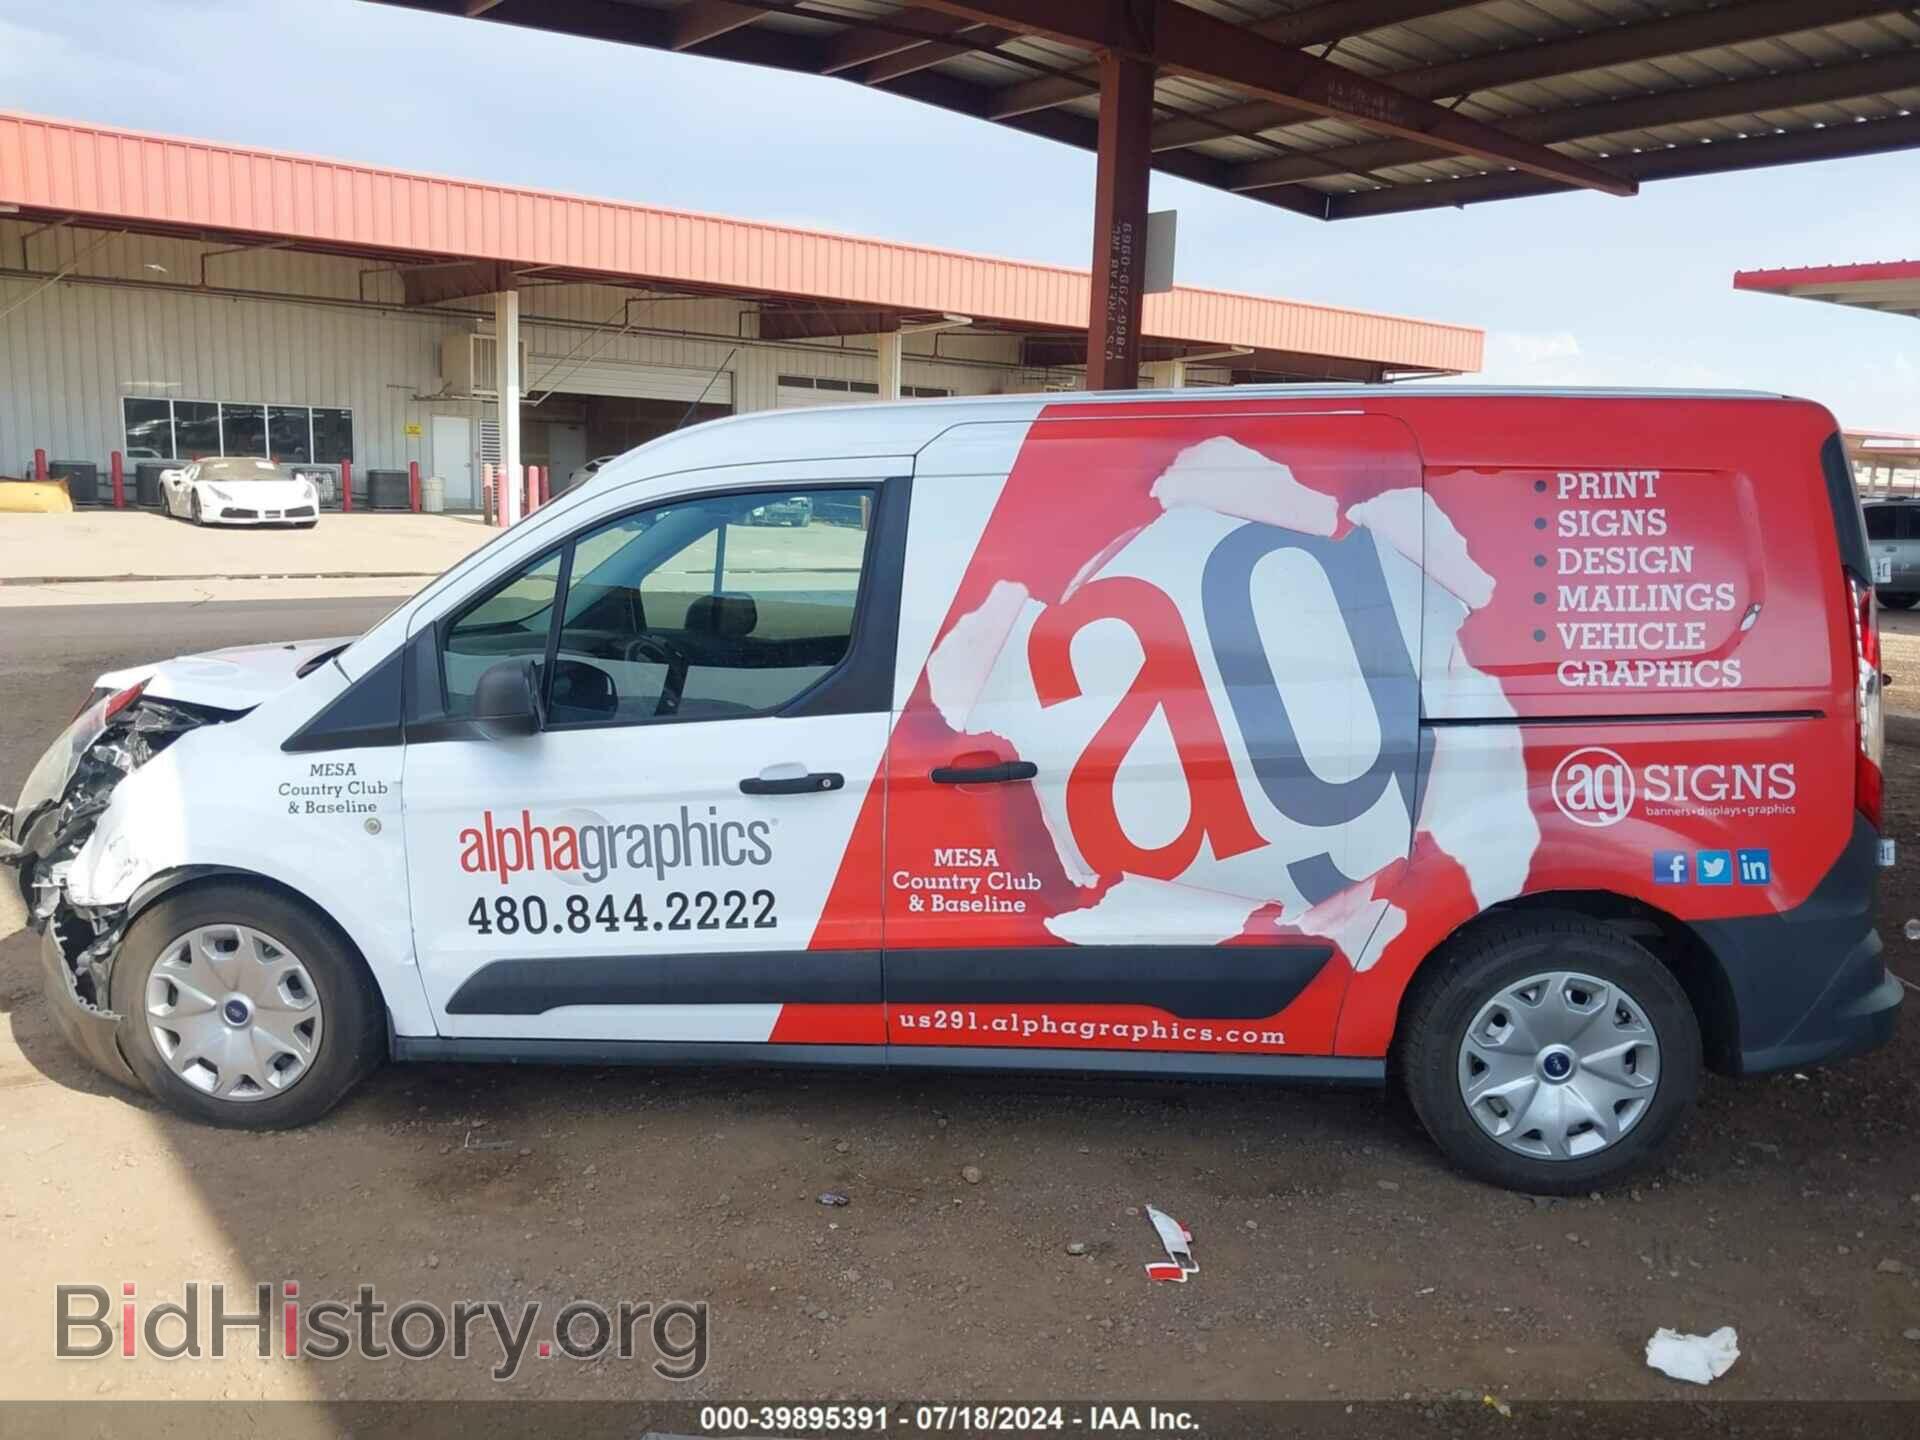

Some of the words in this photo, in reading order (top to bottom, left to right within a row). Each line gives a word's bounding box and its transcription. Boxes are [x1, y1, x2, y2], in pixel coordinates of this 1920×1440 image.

[1557, 470, 1660, 499] PRINT
[1557, 508, 1668, 537] SIGNS
[1557, 546, 1694, 575] DESIGN
[1557, 583, 1736, 612] MAILINGS
[1556, 622, 1706, 650] VEHICLE
[1557, 659, 1742, 688] GRAPHICS
[310, 762, 357, 777] MESA
[278, 782, 342, 798] Country
[348, 780, 388, 795] Club
[1566, 763, 1625, 823] ag
[1643, 763, 1797, 801] SIGNS
[288, 801, 299, 814] &
[305, 799, 378, 814] Baseline
[459, 805, 773, 885] alphagraphics
[933, 848, 1000, 867] MESA
[892, 871, 980, 893] Country
[986, 870, 1042, 890] Club
[468, 888, 778, 935] 480.844.2222
[908, 894, 924, 912] &
[931, 893, 1027, 913] Baseline
[899, 1009, 1286, 1045] us291.alphagraphics.com
